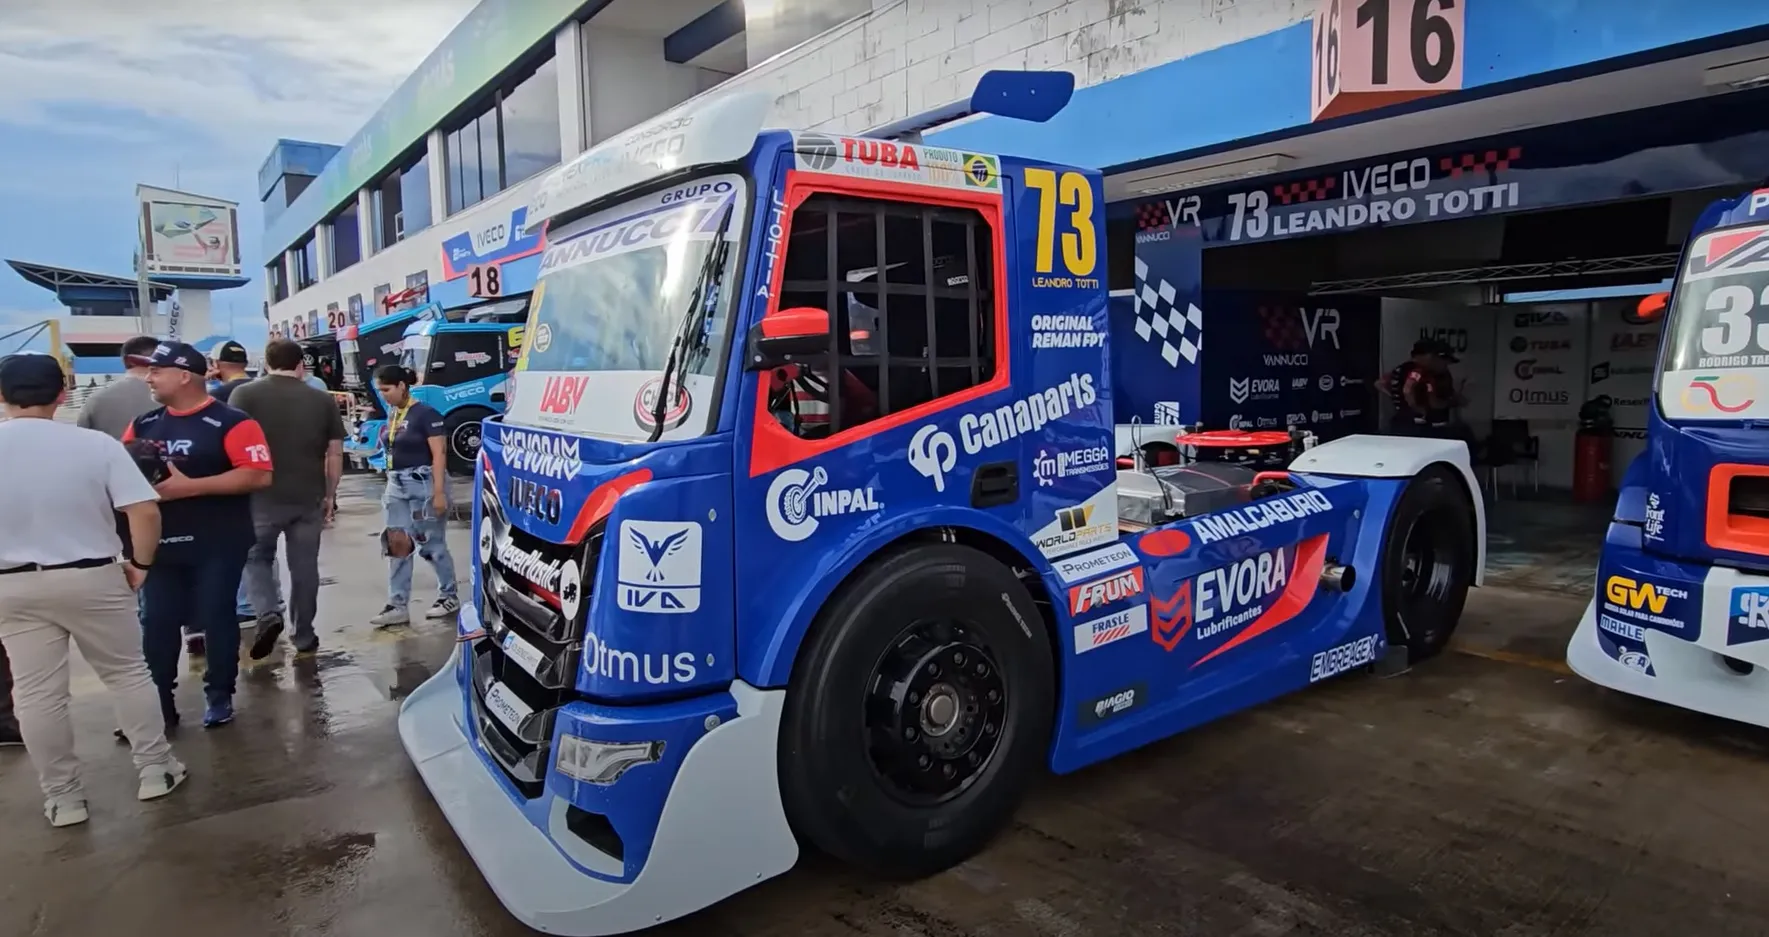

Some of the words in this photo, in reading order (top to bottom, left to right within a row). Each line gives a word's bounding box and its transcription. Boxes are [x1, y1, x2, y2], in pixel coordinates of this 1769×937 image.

[1356, 0, 1456, 85] 16
[840, 138, 920, 171] TUBA
[923, 148, 958, 163] PRODUTO
[1342, 157, 1430, 200] IVECO
[661, 181, 732, 205] GRUPO
[1165, 195, 1201, 229] VR
[1228, 189, 1269, 241] 73
[1273, 199, 1416, 236] LEANDRO
[1424, 182, 1520, 217] TOTTI
[1024, 167, 1097, 277] 73
[476, 223, 505, 248] IVECO
[471, 266, 500, 296] 18
[1032, 276, 1073, 288] LEANDRO
[1075, 278, 1099, 289] TOTTI
[292, 323, 307, 337] 21
[327, 311, 346, 328] 20
[1031, 314, 1094, 331] ORIGINAL
[1299, 307, 1341, 350] VR
[1032, 332, 1082, 348] REMAN
[1082, 332, 1106, 348] FPT
[1263, 354, 1308, 366] VANNUCCI
[1698, 355, 1749, 368] RODRIGO
[445, 386, 486, 402] IVECO
[1251, 378, 1280, 393] EVORA
[1509, 388, 1569, 404] Otmus
[958, 373, 1097, 455] Canaparts
[166, 440, 193, 455] VR
[245, 444, 270, 462] 73
[1064, 446, 1109, 467] MEGGA
[508, 475, 563, 526] IVECO
[1191, 490, 1334, 545] AMALCABURIO
[1062, 550, 1132, 575] PROMETEON
[1075, 570, 1140, 615] FRUM
[1195, 547, 1287, 623] EVORA
[1606, 575, 1668, 614] GW
[1656, 585, 1688, 600] TECH
[627, 589, 686, 609] IVA
[1197, 604, 1263, 640] Lubrificantes
[1601, 615, 1643, 640] MAHLE
[583, 631, 696, 684] Otmus
[1310, 633, 1378, 683] EMBREAGEX
